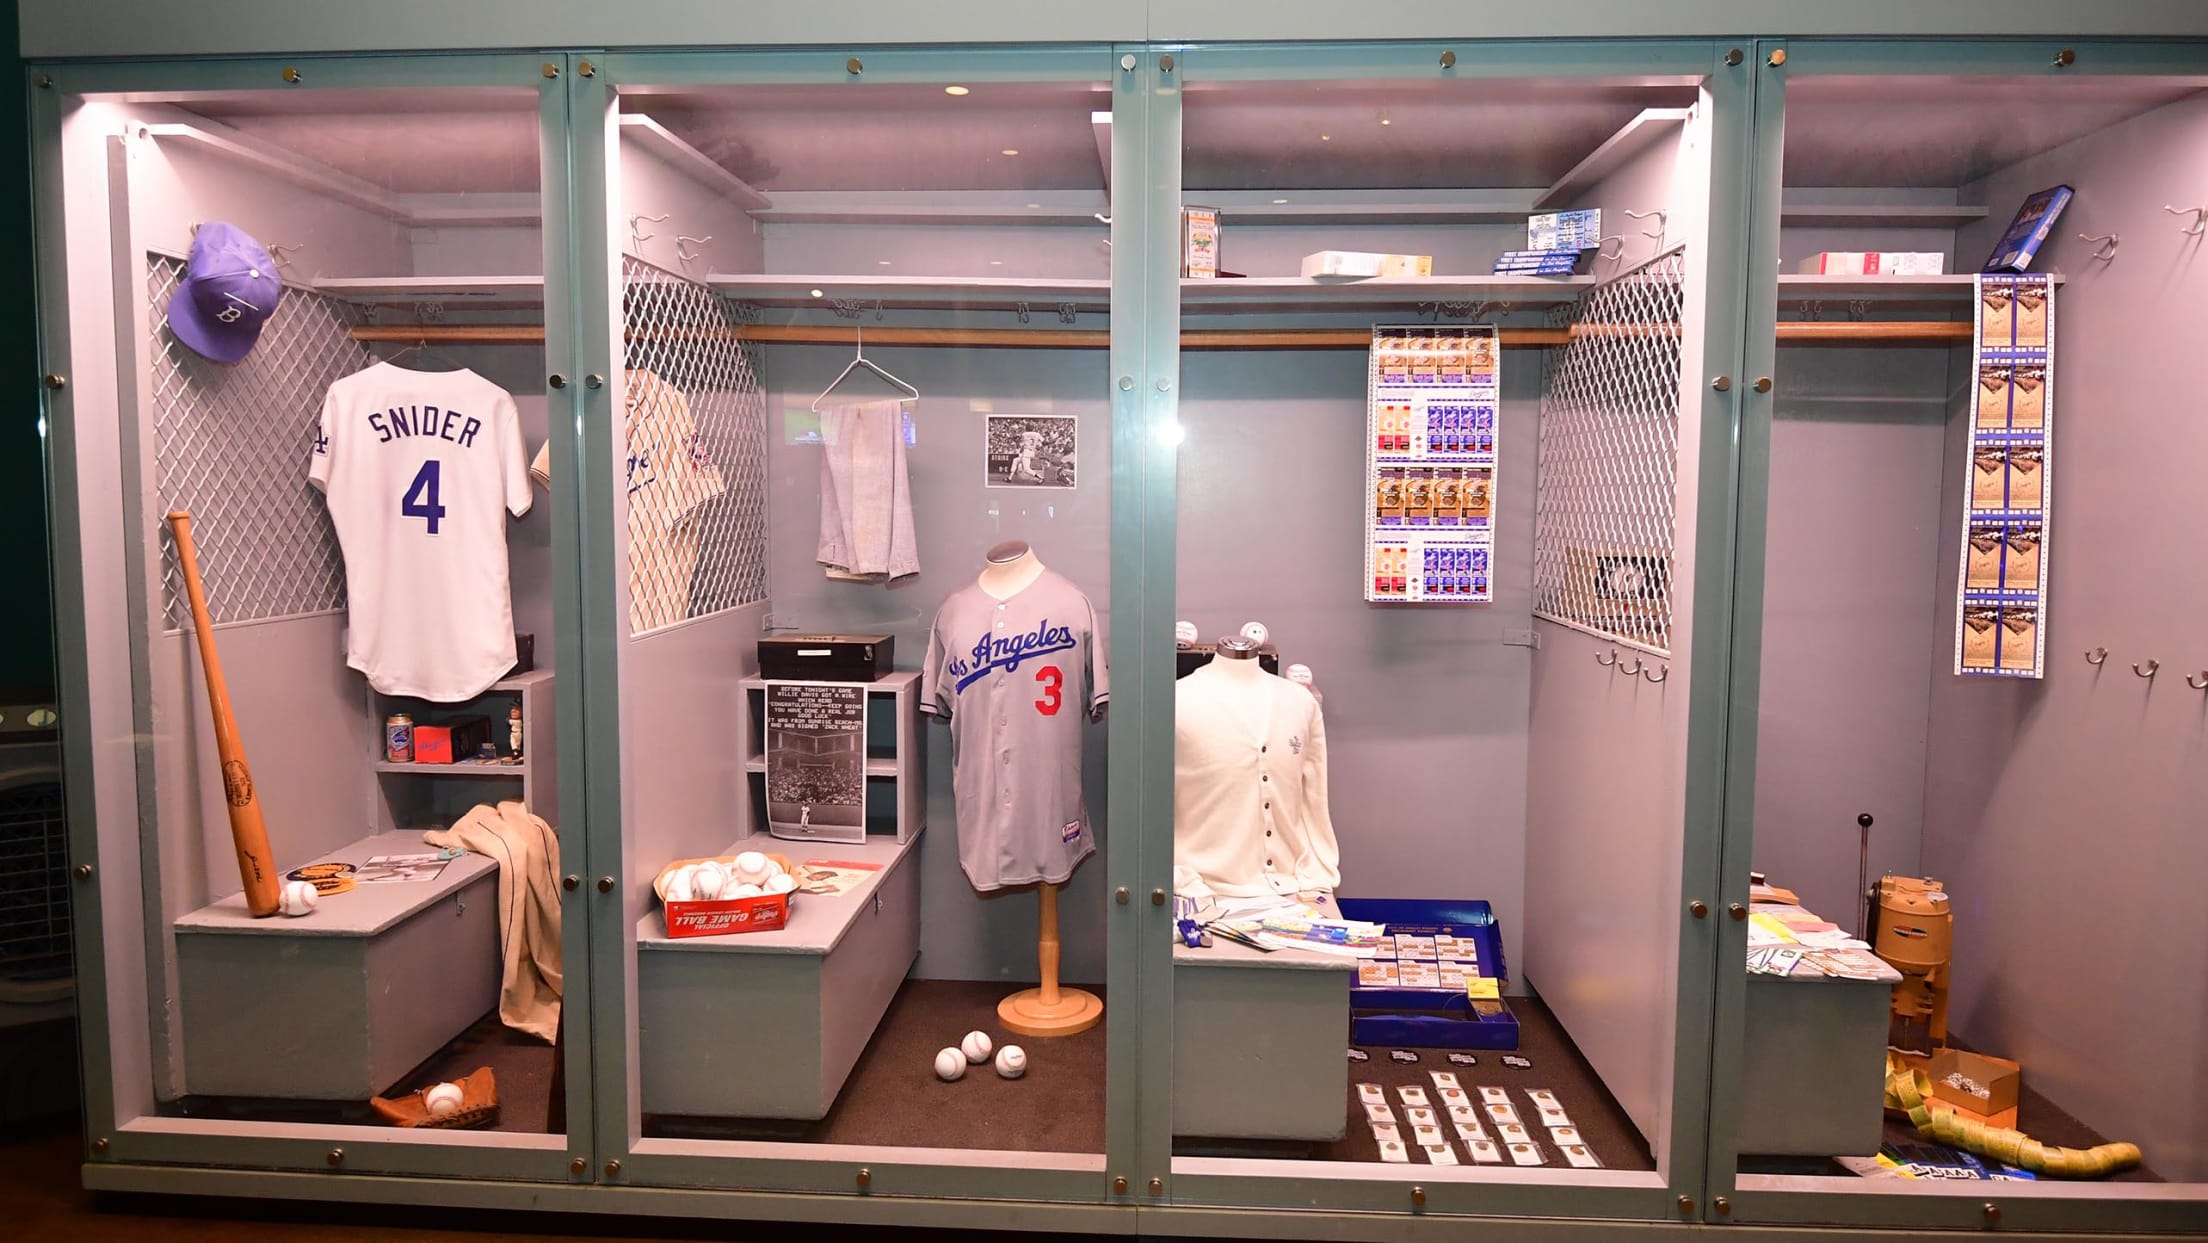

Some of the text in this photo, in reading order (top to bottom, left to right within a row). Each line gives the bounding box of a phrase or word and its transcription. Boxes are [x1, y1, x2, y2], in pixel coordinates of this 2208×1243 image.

[215, 305, 242, 323] B
[367, 405, 482, 448] SNIDER
[401, 459, 446, 535] 4
[971, 618, 1076, 673] Angeles
[1034, 665, 1064, 716] 3
[675, 915, 708, 926] BALL
[710, 912, 750, 924] GAME
